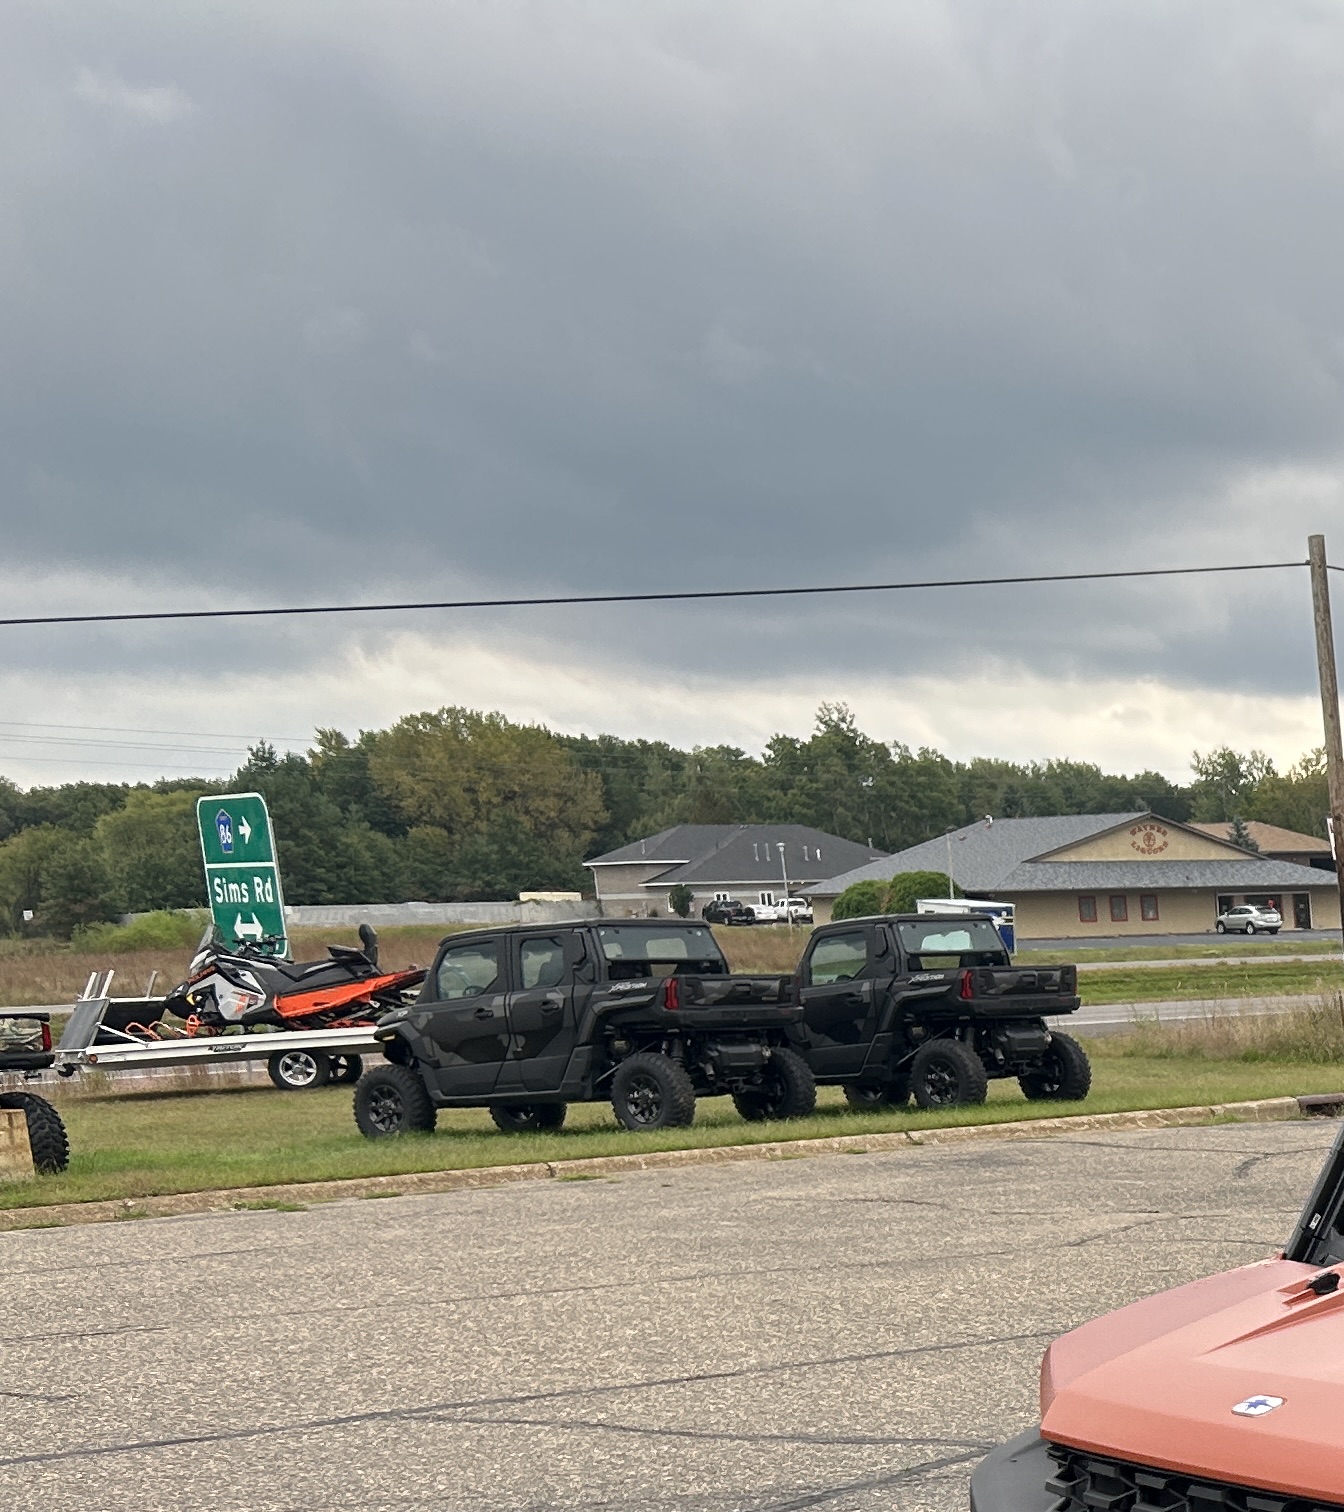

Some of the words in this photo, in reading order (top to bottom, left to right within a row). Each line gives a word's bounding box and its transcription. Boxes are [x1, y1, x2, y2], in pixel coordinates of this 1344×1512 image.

[219, 824, 233, 844] 86
[213, 876, 249, 903] Sims
[253, 876, 274, 903] Rd
